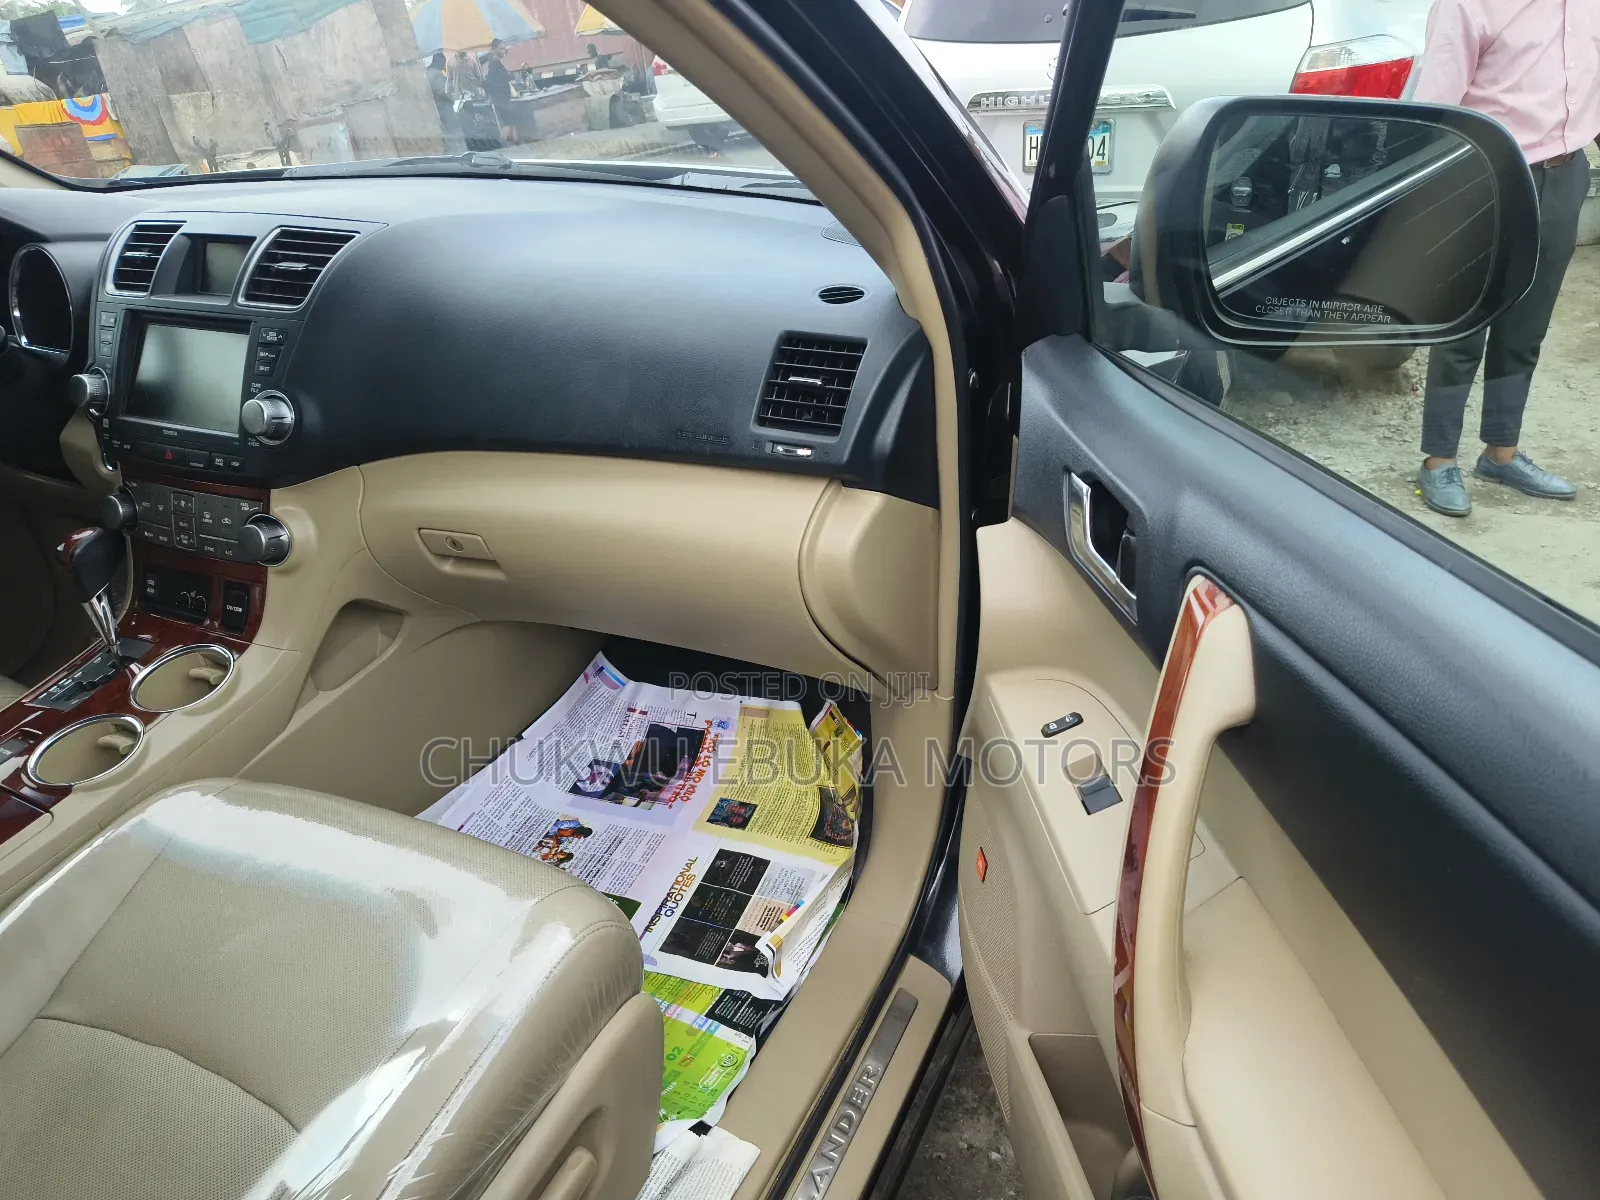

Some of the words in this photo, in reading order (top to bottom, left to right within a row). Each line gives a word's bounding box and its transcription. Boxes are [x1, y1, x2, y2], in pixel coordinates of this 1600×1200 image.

[1255, 304, 1293, 316] CLOSER
[1295, 307, 1321, 318] THAN
[1323, 310, 1350, 321] THEY
[1350, 312, 1391, 324] APPEAR
[1265, 296, 1306, 308] OBJECTS
[1309, 299, 1320, 309] IN
[1322, 301, 1361, 312] MIRROR
[1363, 303, 1385, 314] ARE
[646, 856, 699, 933] INSPIRATIONAL
[664, 873, 697, 918] QUOTES
[806, 1064, 882, 1200] ANDER
